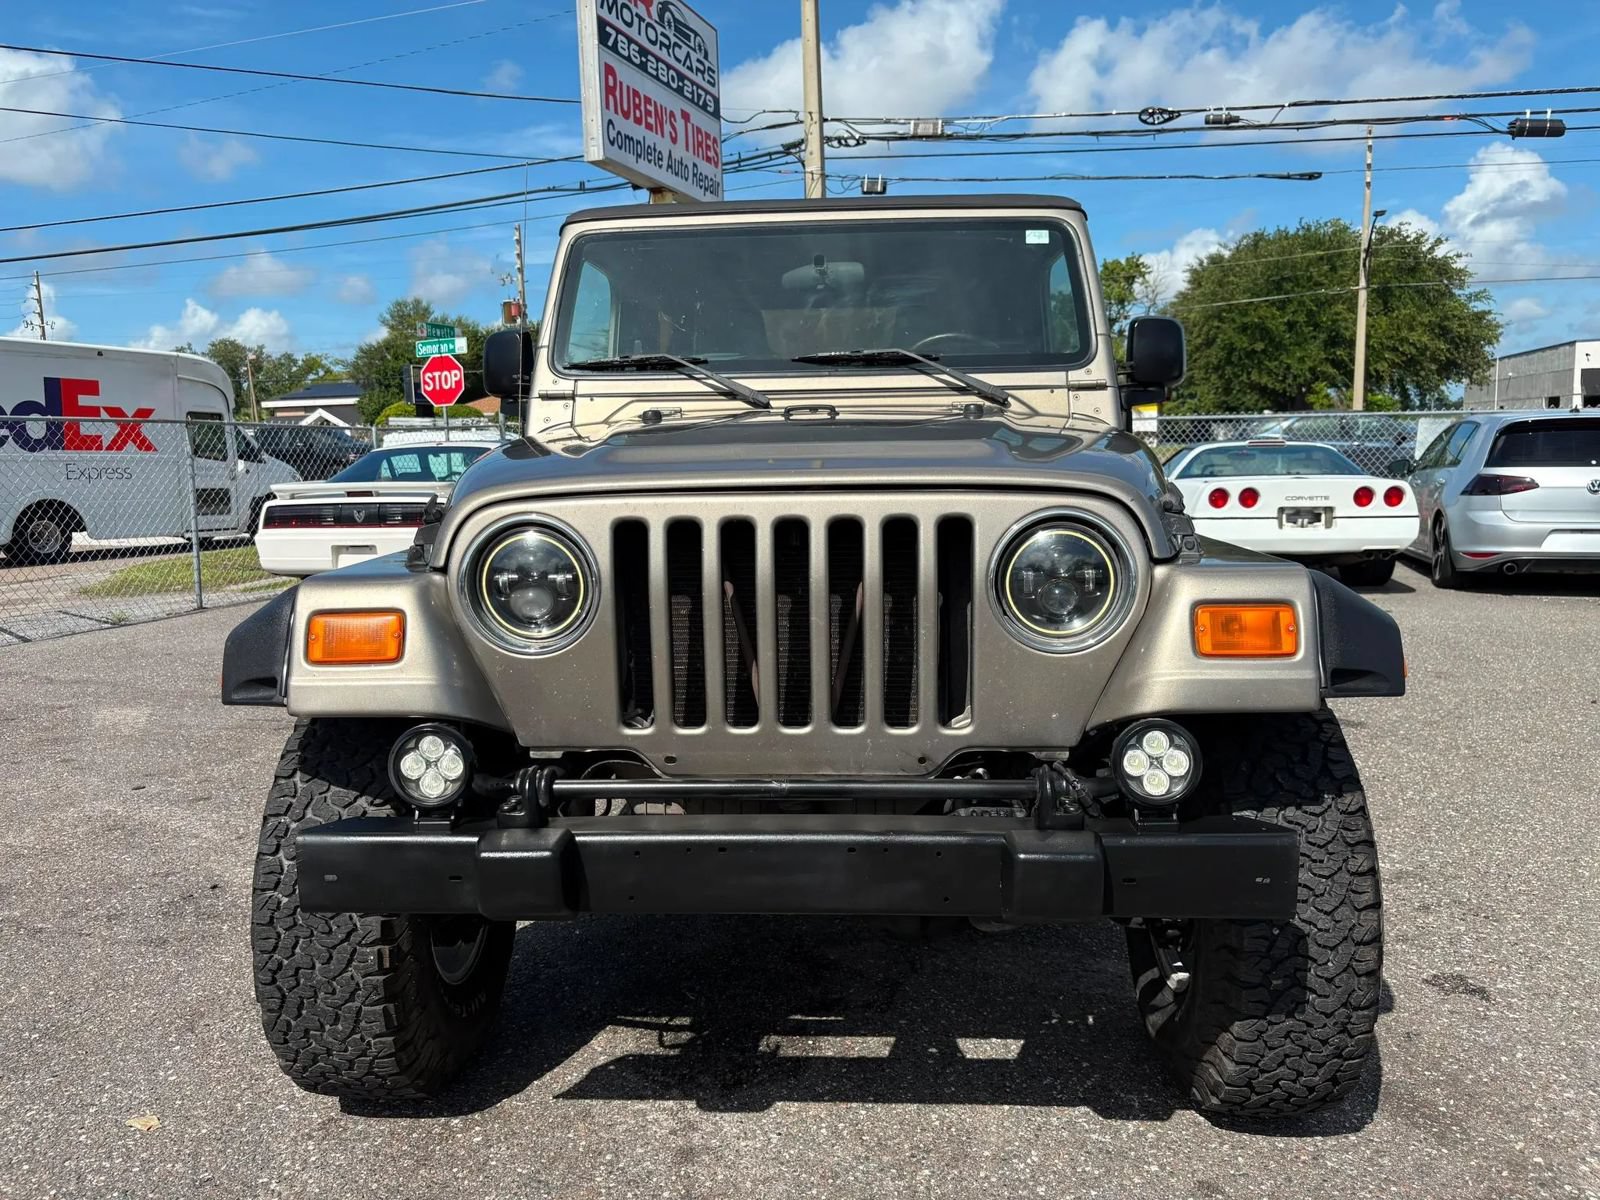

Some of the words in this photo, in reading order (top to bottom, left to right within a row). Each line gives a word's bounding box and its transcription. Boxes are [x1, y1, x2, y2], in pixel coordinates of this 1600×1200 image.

[600, 0, 716, 89] MOTORCARS
[605, 26, 715, 112] 786-280-2179
[604, 62, 678, 146] RUBEN'S
[680, 108, 720, 169] TIRES
[606, 119, 663, 170] Complete
[666, 149, 690, 185] Auto
[692, 162, 720, 198] Repair
[418, 343, 448, 355] Semoran
[424, 370, 460, 391] STOP
[66, 463, 133, 483] Express
